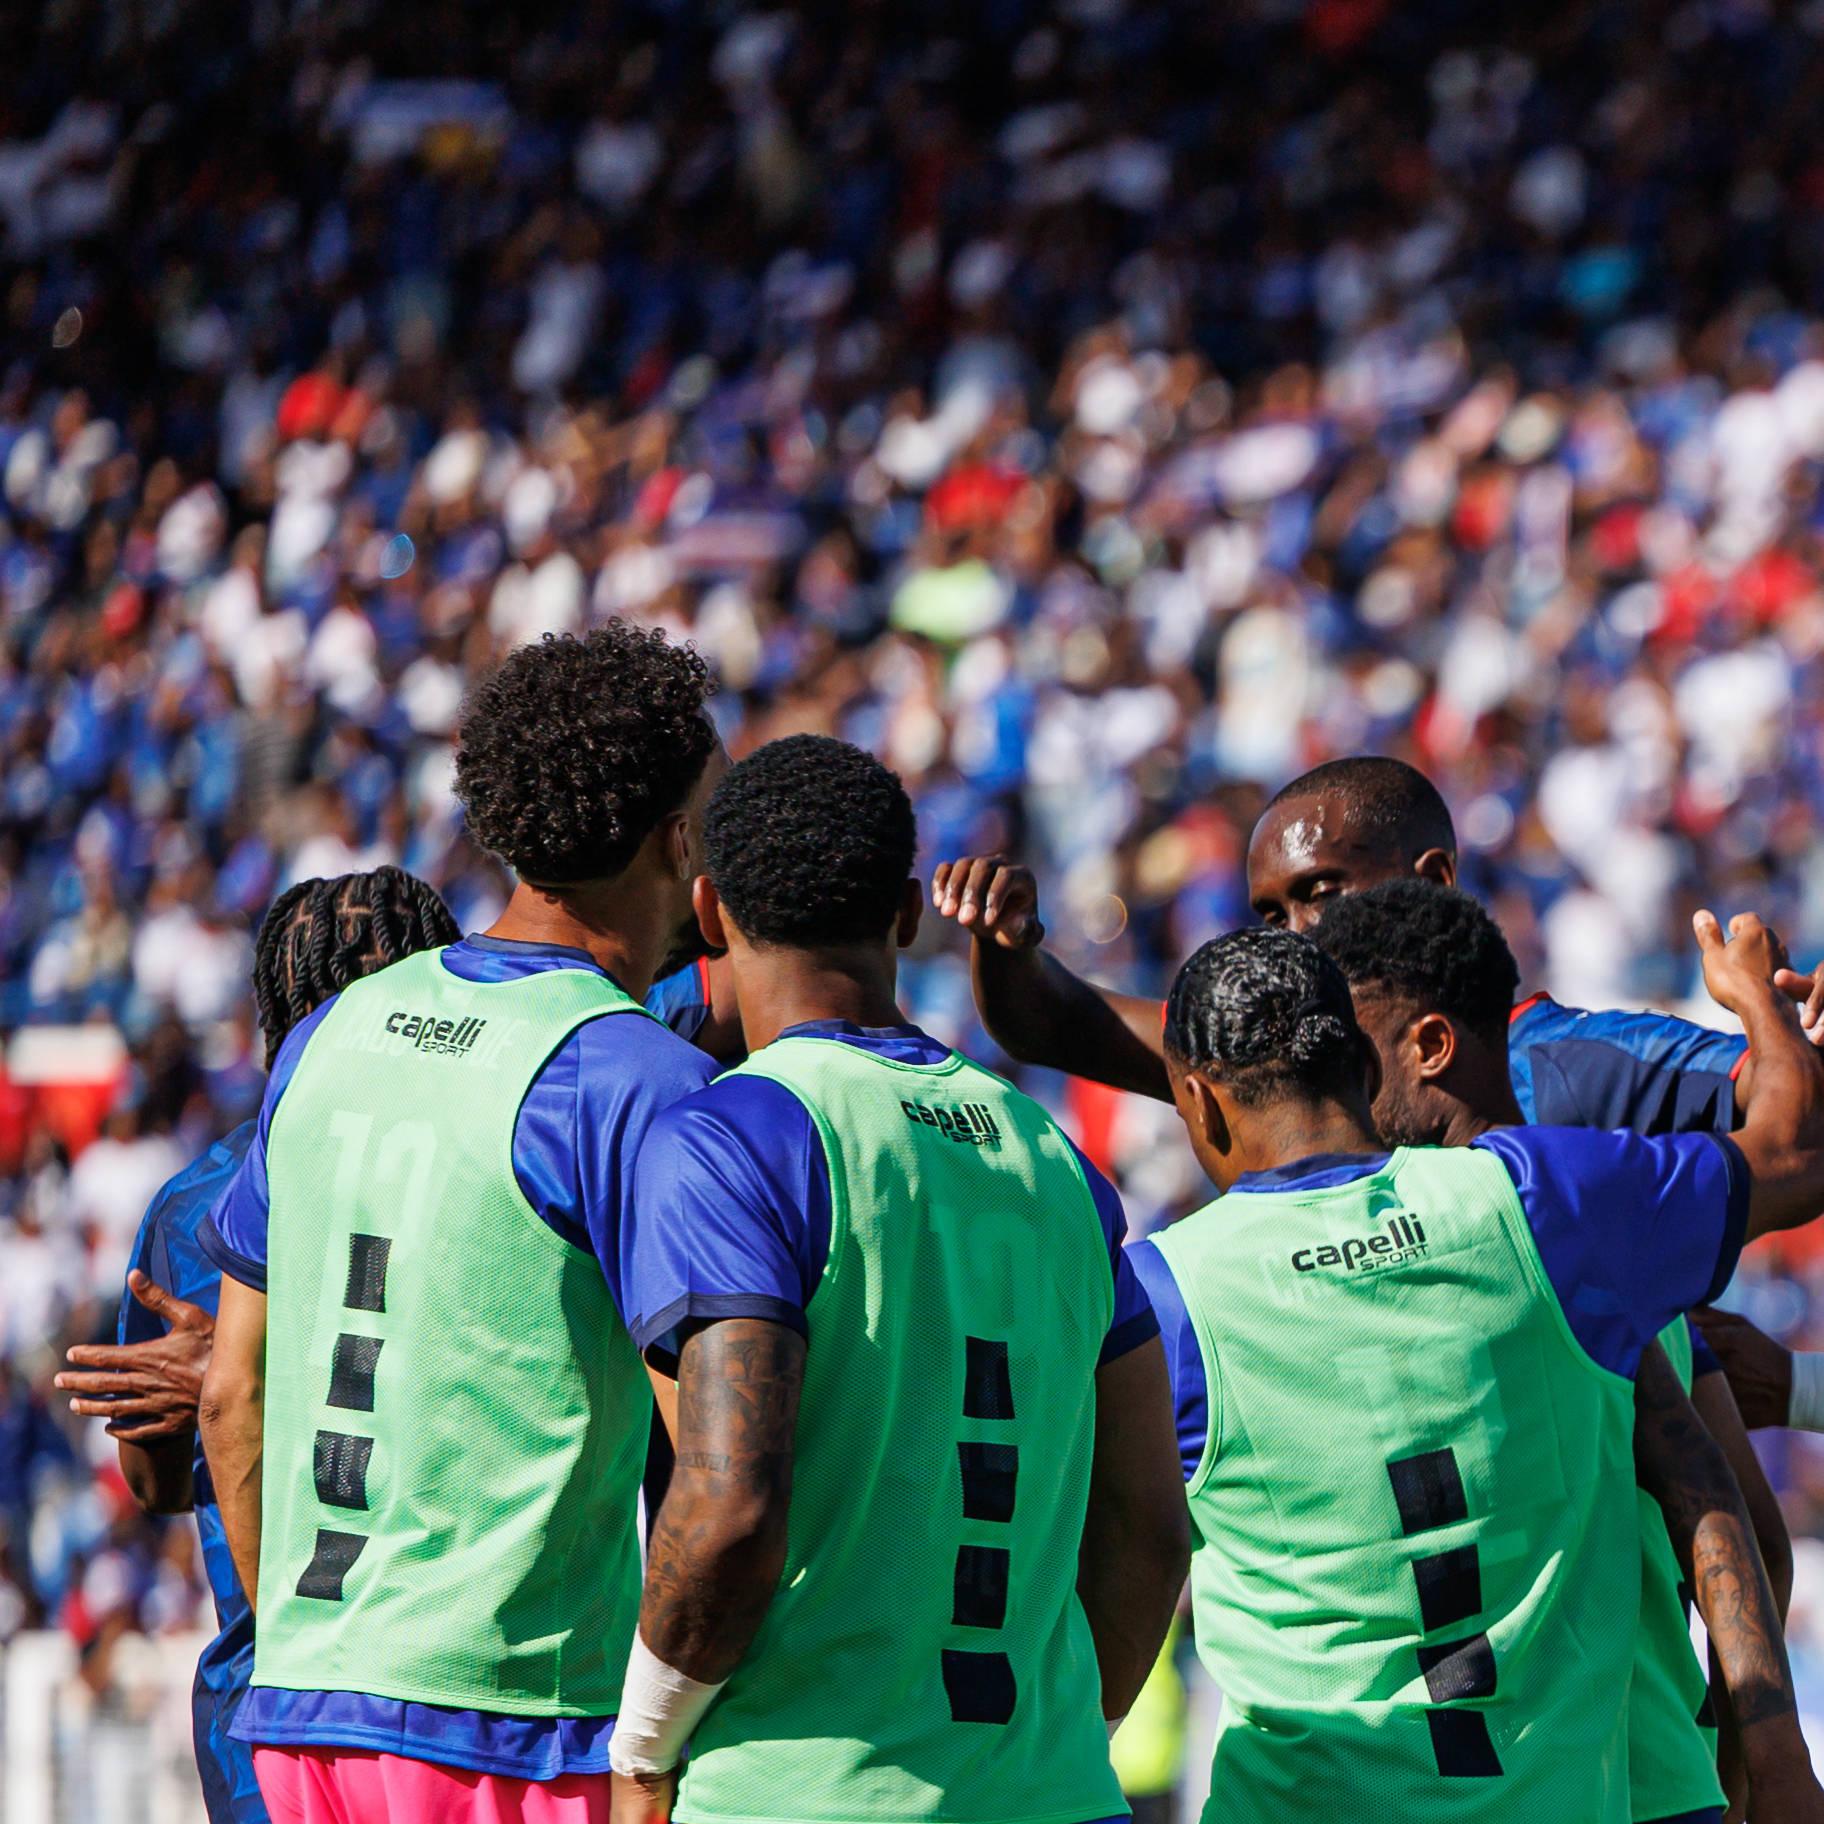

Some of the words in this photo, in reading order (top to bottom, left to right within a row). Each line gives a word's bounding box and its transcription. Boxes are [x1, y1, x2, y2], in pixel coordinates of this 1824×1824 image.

[385, 1012, 487, 1048] capelli
[421, 1041, 470, 1058] SPORT
[900, 1100, 1001, 1138] capelli
[950, 1131, 1003, 1146] SPORT
[1292, 1213, 1426, 1272] capelli
[1360, 1243, 1428, 1271] SPORT
